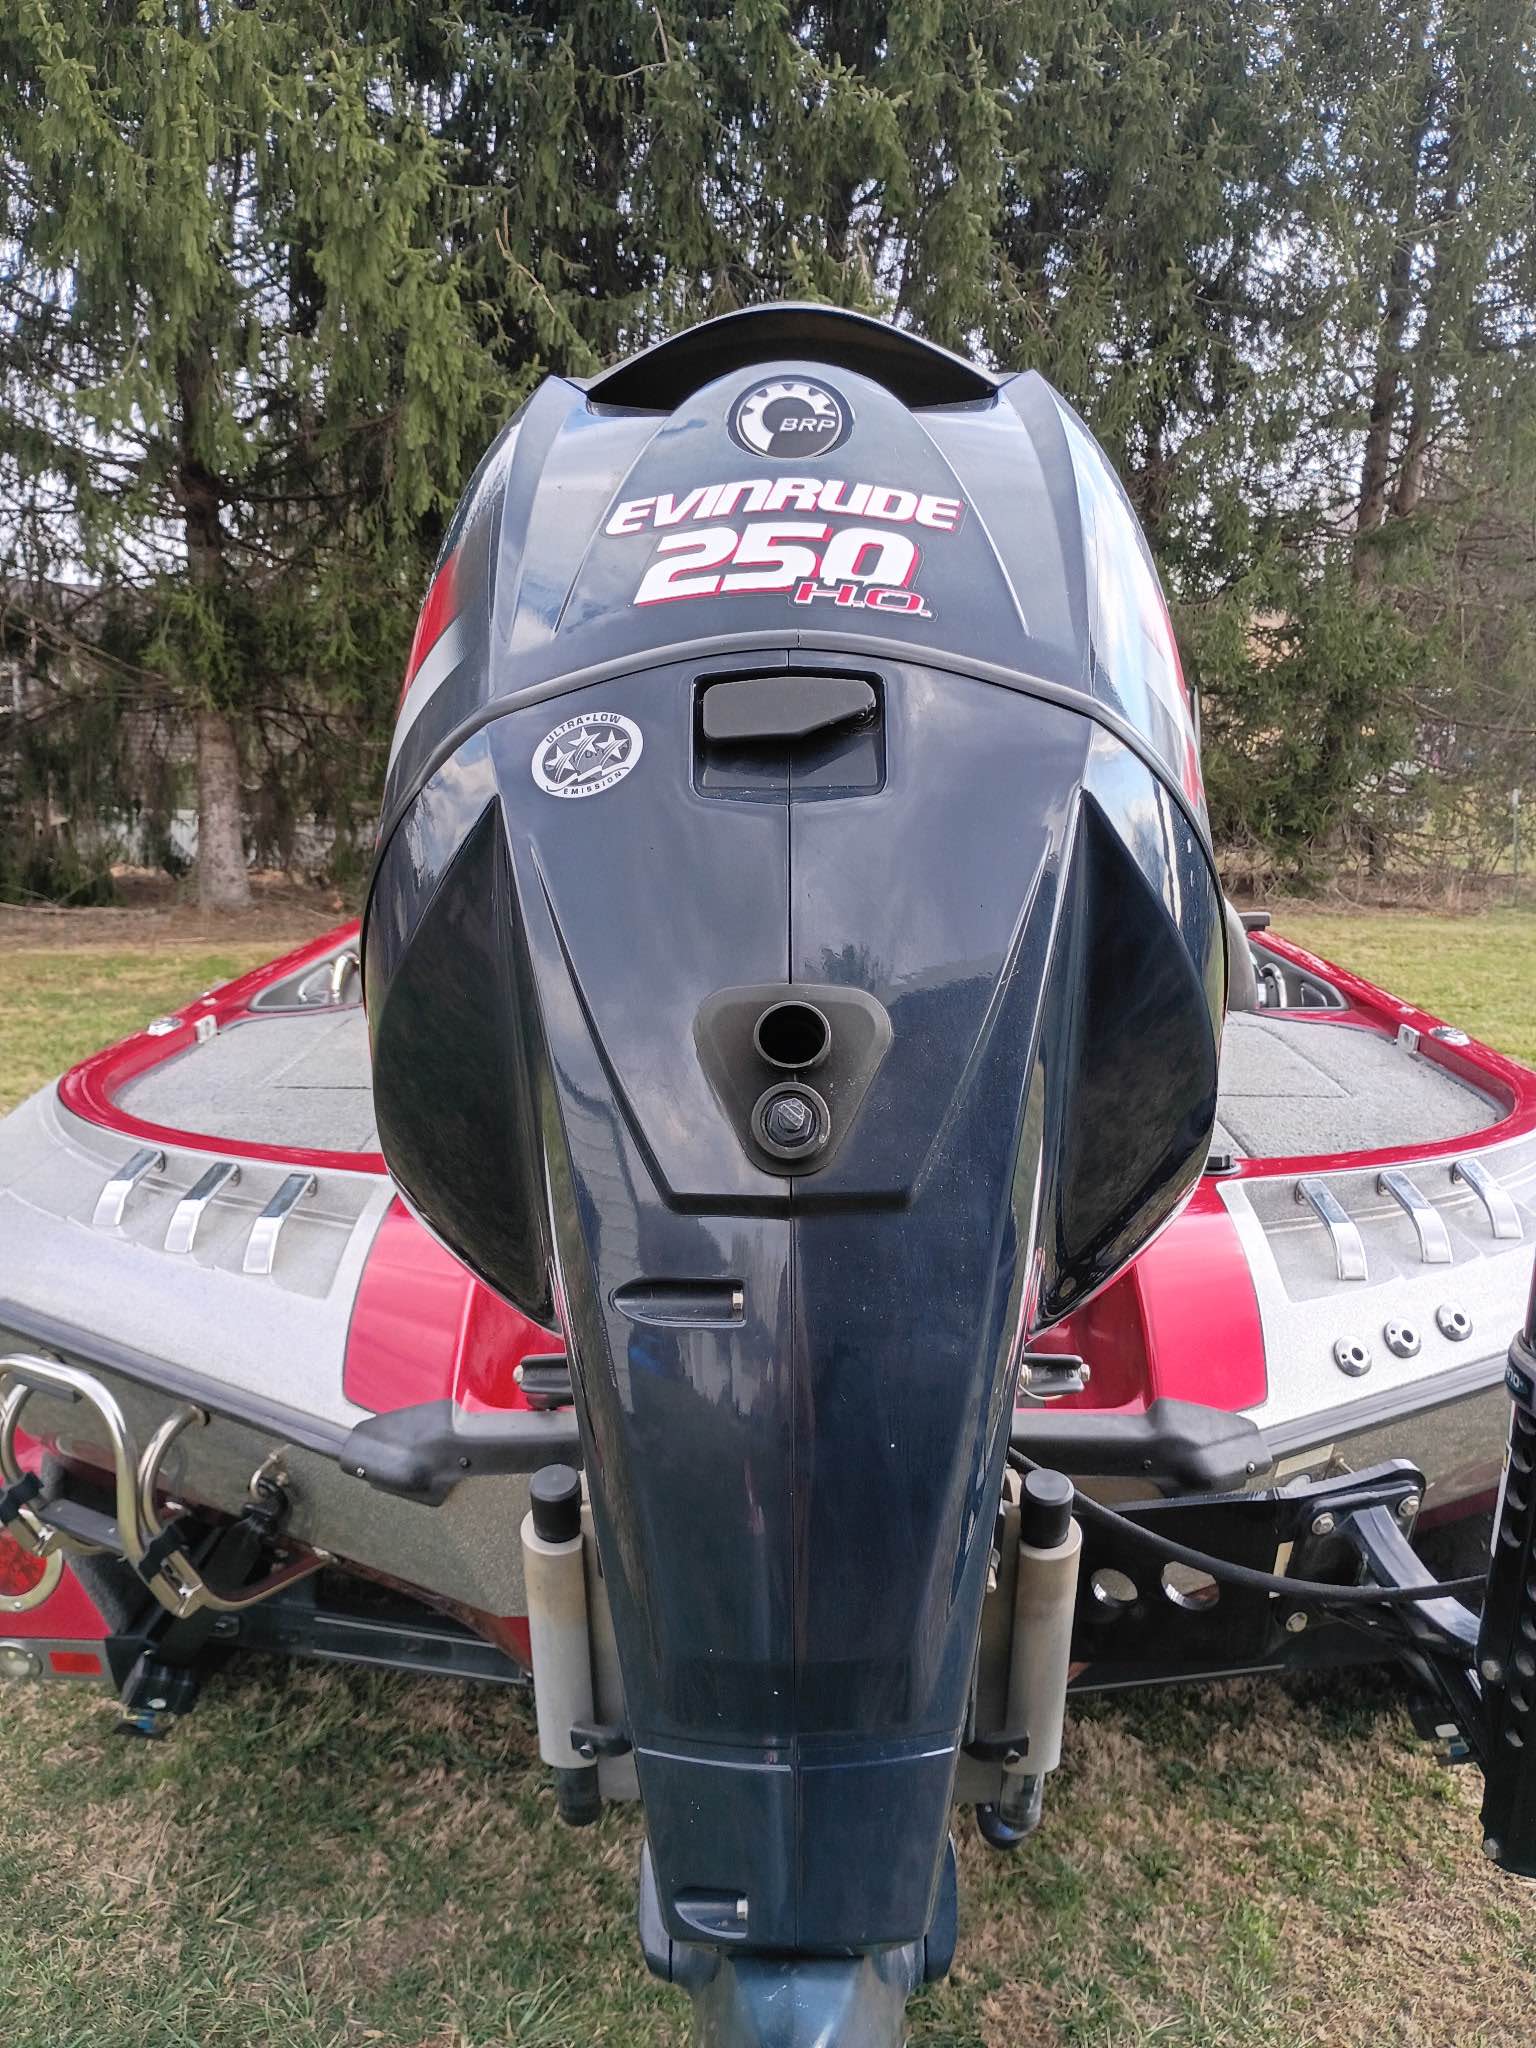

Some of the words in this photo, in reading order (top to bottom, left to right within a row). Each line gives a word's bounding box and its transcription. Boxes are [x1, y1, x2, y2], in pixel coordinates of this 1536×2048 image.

[779, 417, 836, 433] BRP
[605, 477, 964, 535] EVINRUDE
[633, 522, 921, 607] 250
[563, 770, 622, 795] EMISSION
